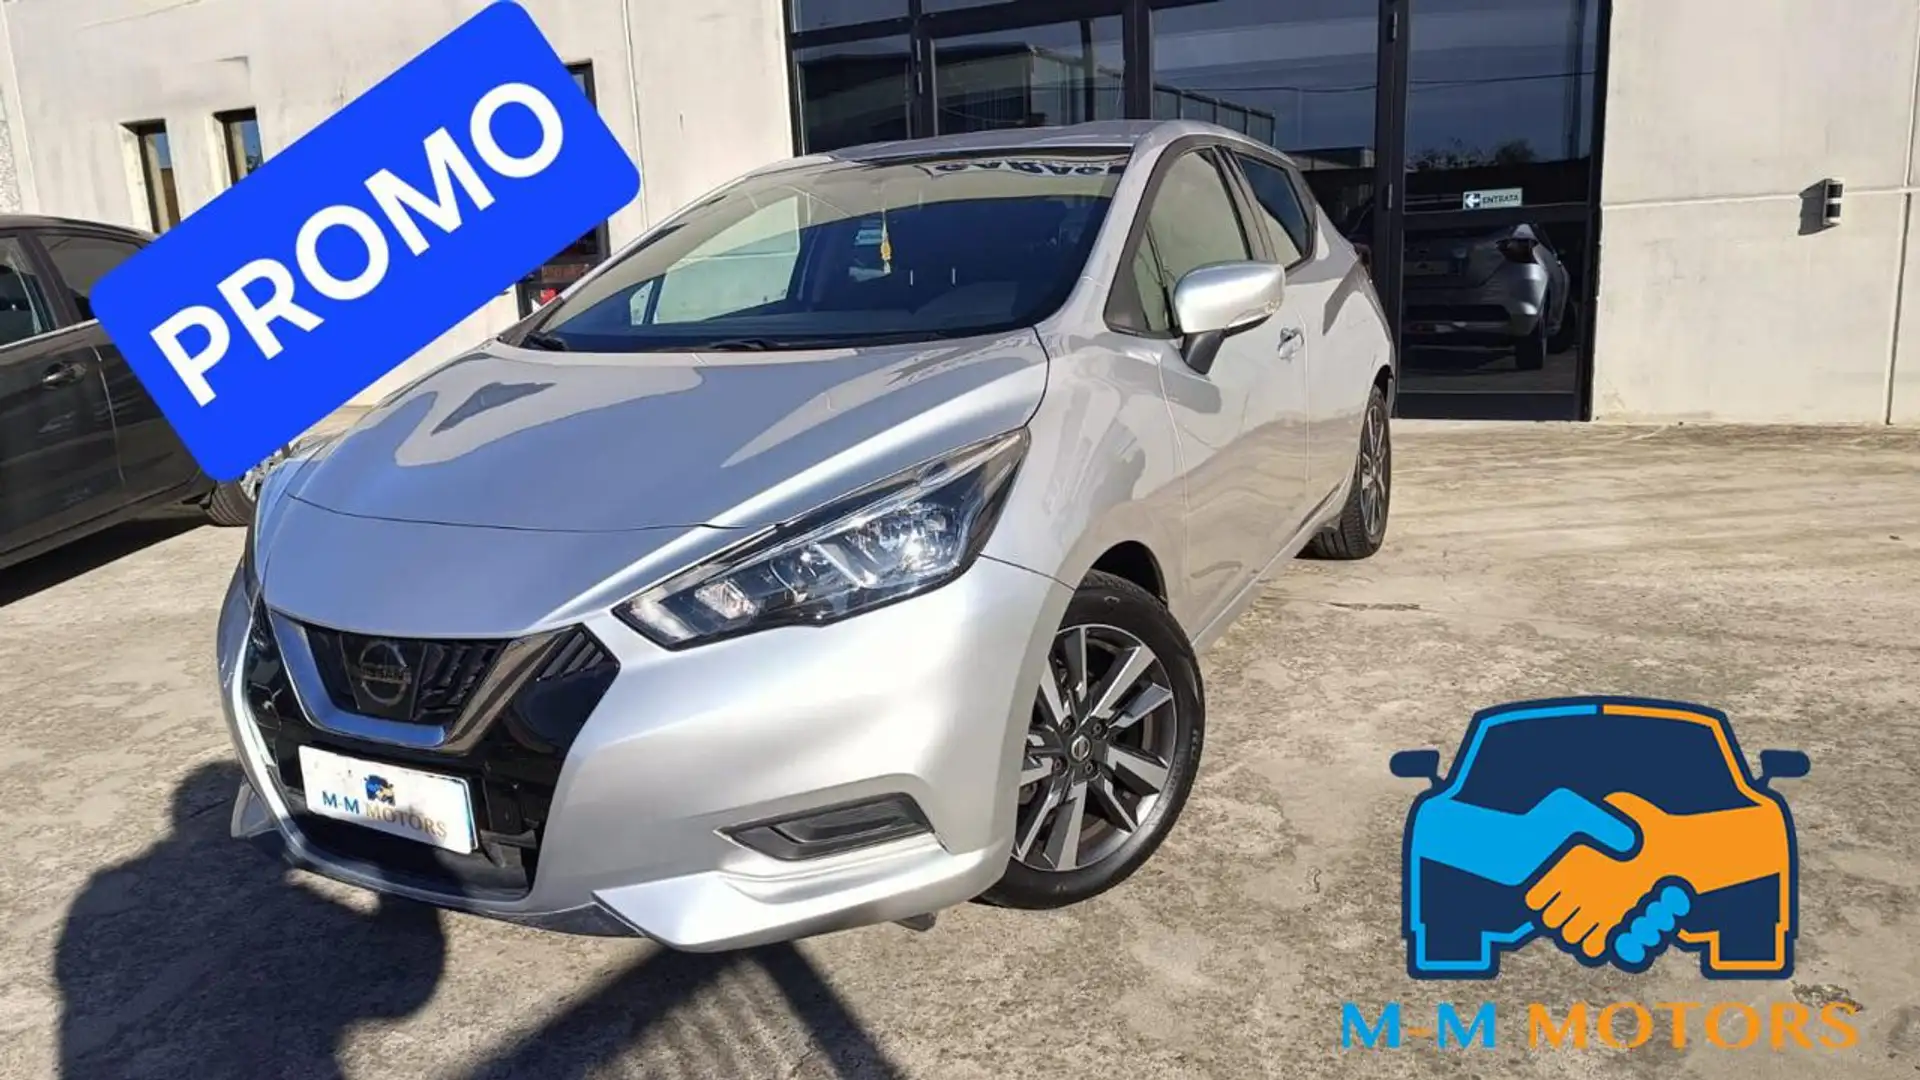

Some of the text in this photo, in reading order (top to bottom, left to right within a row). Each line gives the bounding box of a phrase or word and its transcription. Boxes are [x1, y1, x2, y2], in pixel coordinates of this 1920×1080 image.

[1482, 194, 1519, 204] ENTRATA
[322, 789, 448, 838] M-M MOTORS
